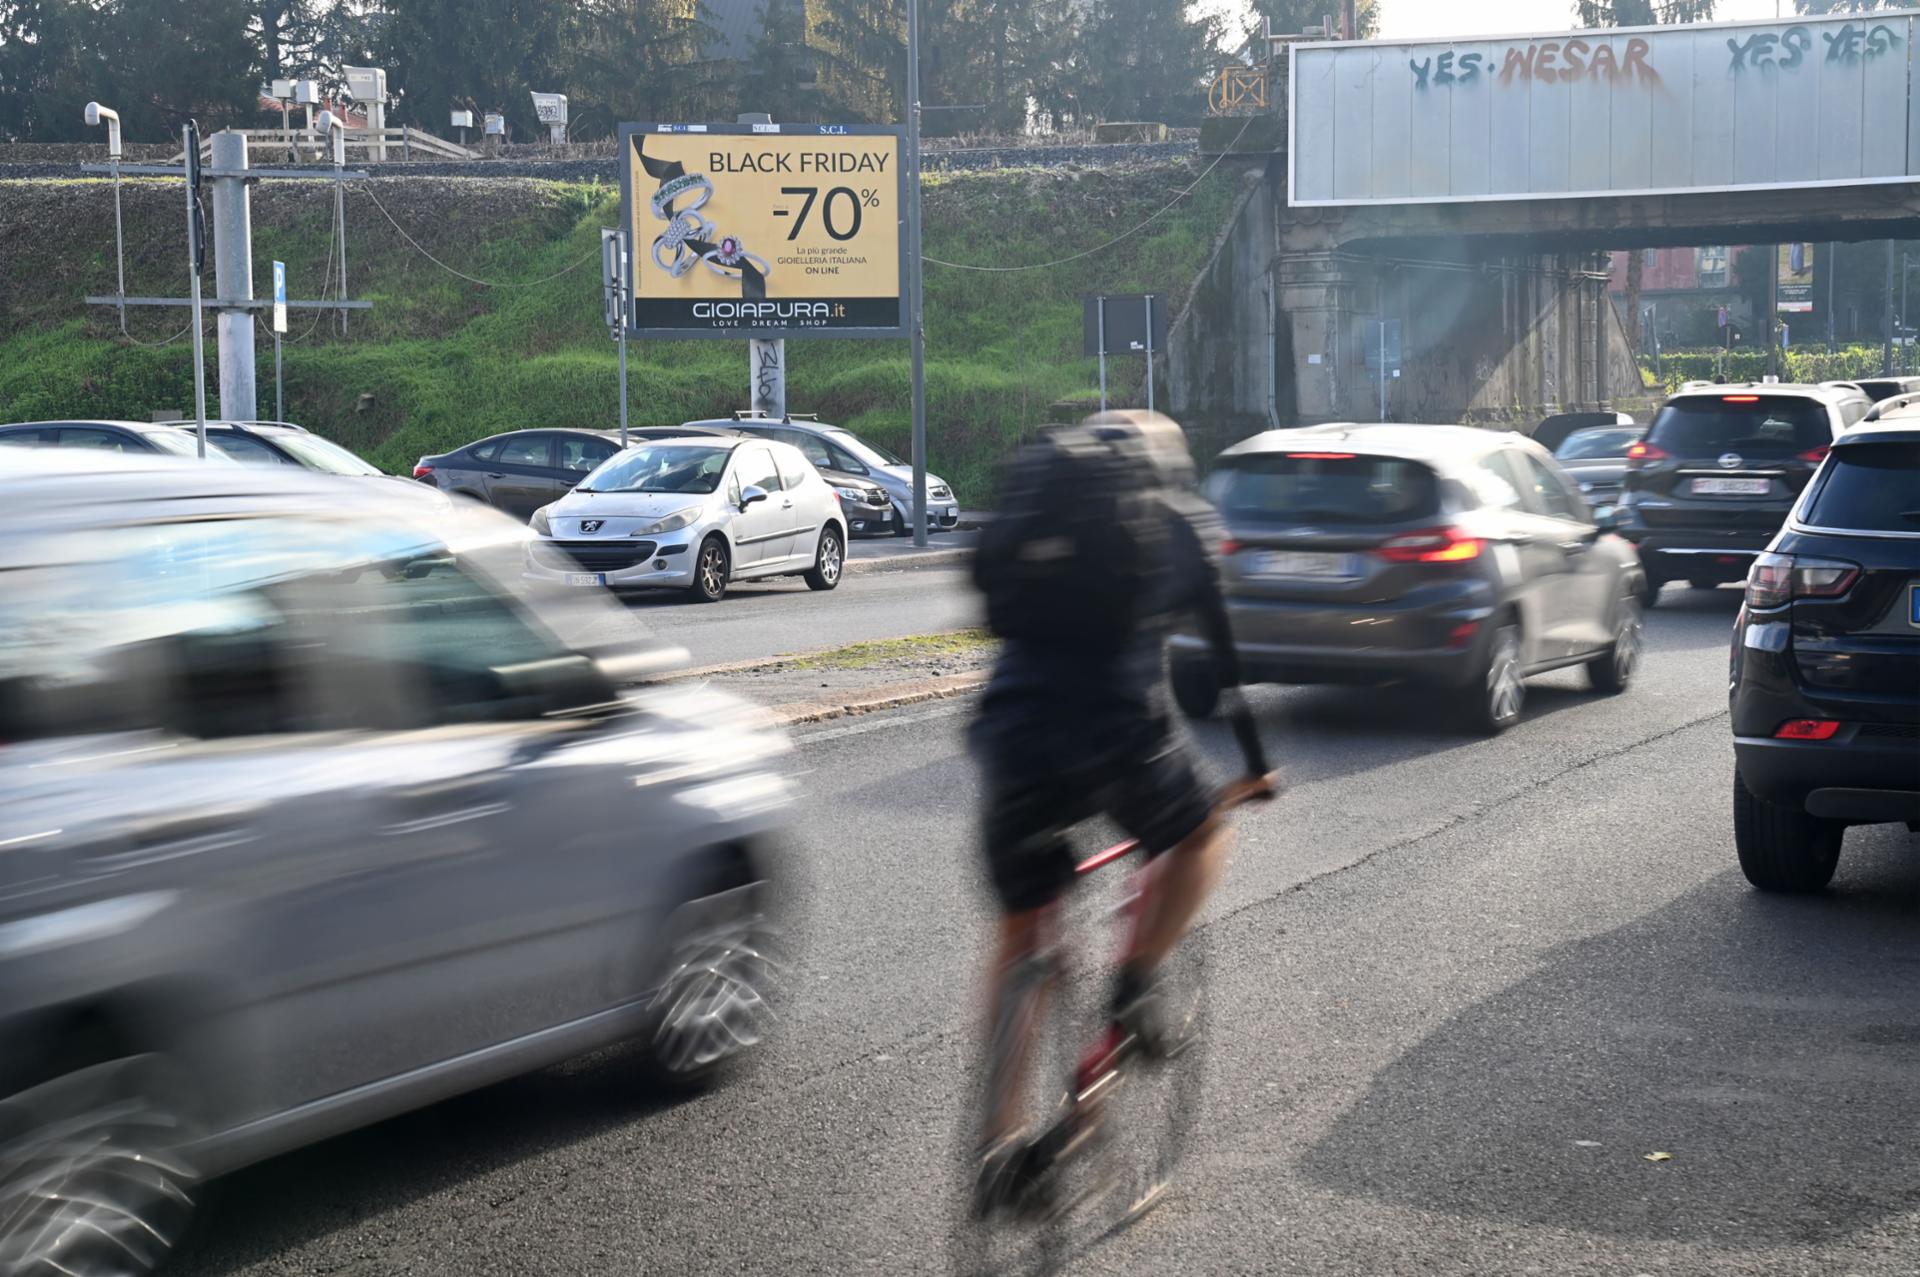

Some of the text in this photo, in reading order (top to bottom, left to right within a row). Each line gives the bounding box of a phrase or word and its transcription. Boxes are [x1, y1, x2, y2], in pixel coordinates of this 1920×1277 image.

[1727, 25, 1812, 72] YES
[819, 125, 847, 134] S.C.I.
[709, 152, 890, 173] BLACK FRIDAY
[796, 247, 806, 255] La
[821, 247, 848, 256] grande
[777, 256, 868, 265] GIOIELLERIA ITALIANA
[805, 266, 840, 275] ON LINE
[692, 302, 846, 318] GIOIAPURA.it
[712, 319, 828, 327] LOVE DREAM SHOP
